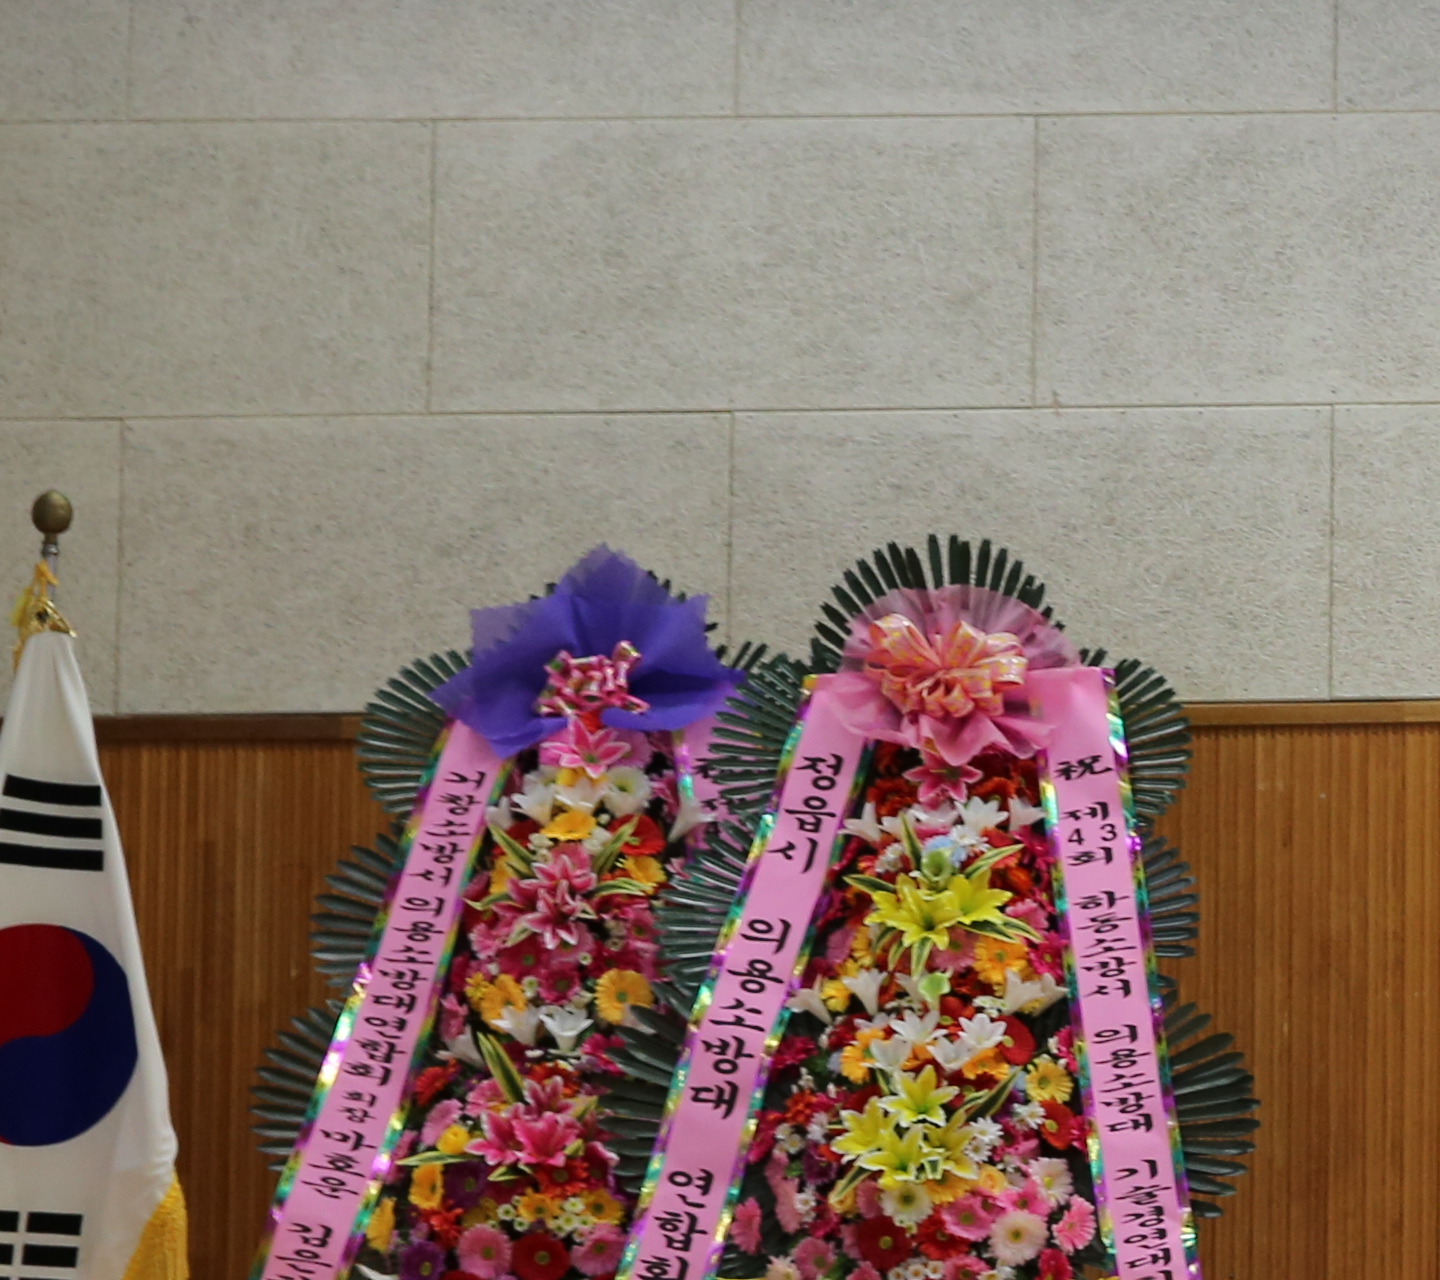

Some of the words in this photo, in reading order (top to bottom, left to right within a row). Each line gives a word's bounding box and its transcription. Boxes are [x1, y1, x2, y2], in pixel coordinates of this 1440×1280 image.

[768, 753, 844, 875] 정읍시
[1054, 754, 1114, 780] 祝
[1076, 889, 1137, 1001] 하동소방서
[690, 917, 792, 1121] 의용소방대
[1091, 1022, 1156, 1136] 의용소방대
